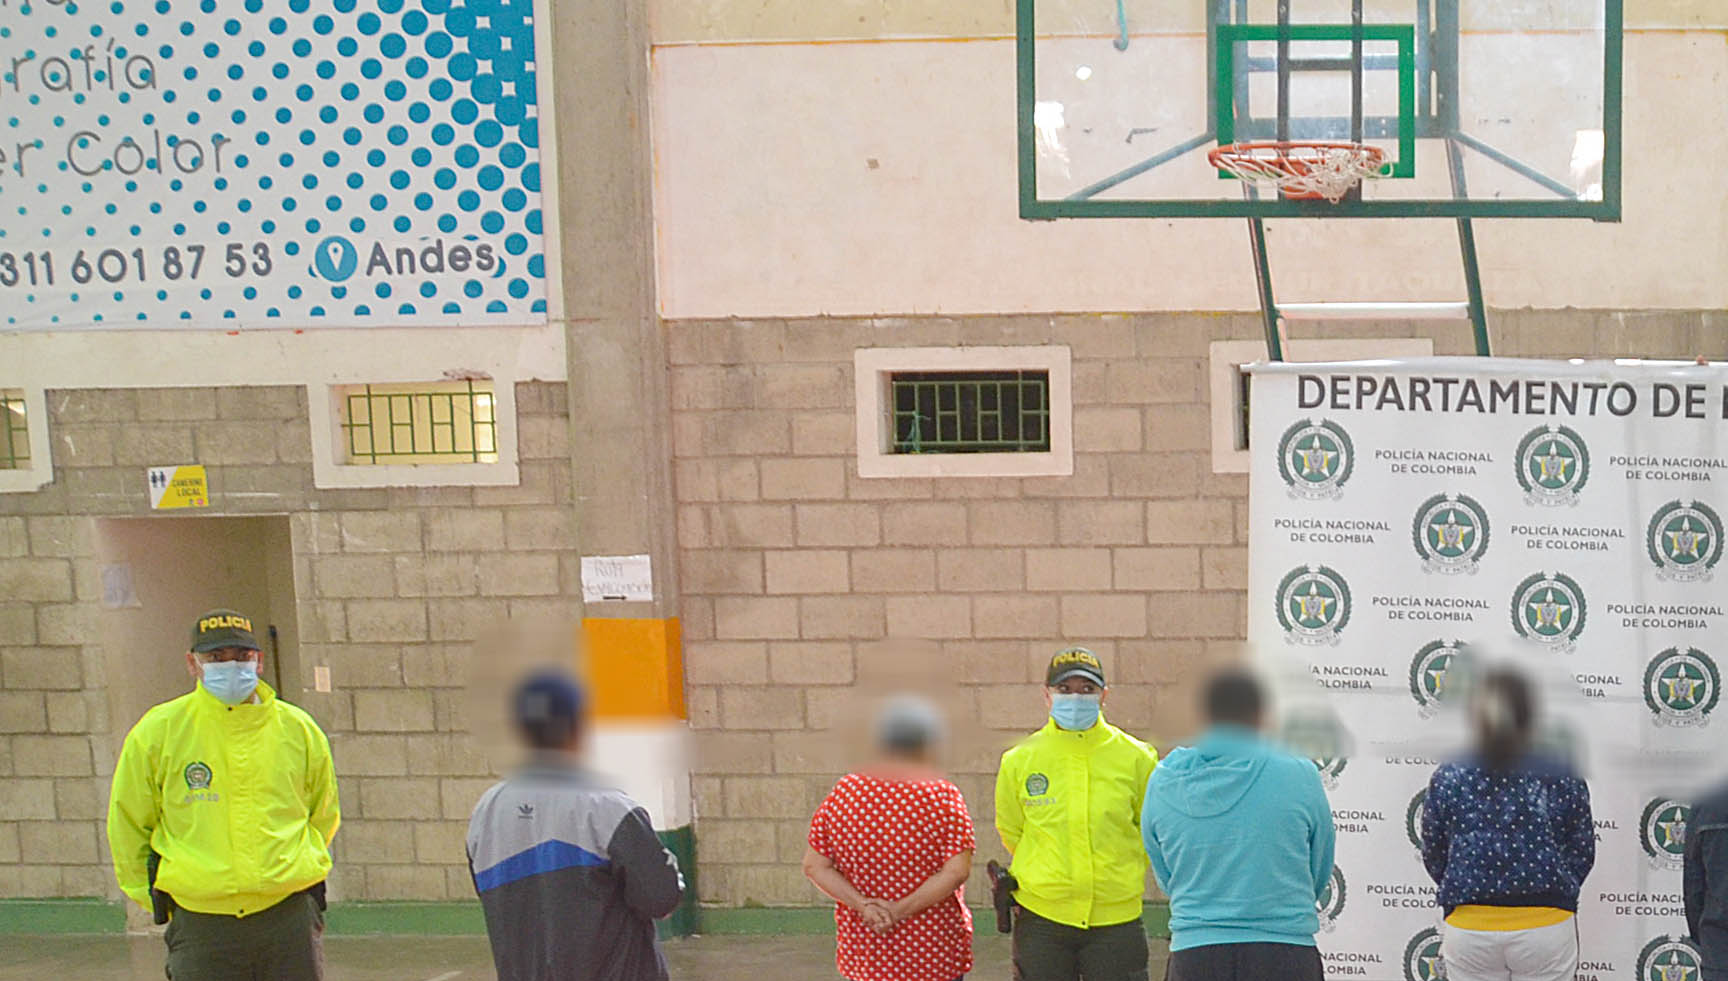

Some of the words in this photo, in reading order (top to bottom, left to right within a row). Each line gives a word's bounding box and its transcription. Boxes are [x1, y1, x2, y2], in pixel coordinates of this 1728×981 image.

[0, 37, 156, 92] rafía
[0, 143, 41, 177] r
[68, 129, 231, 176] Color
[0, 251, 55, 287] 311
[71, 248, 146, 284] 601
[163, 244, 206, 280] 87
[225, 242, 272, 277] 53
[366, 239, 495, 276] Andes
[1298, 375, 1637, 416] DEPARTAMENTO
[1653, 383, 1706, 419] DE
[1376, 450, 1424, 460] POLICÍA
[1428, 452, 1493, 462] NACIONAL
[1610, 457, 1659, 466] POLICÍA
[1663, 458, 1727, 468] NACIONAL
[1392, 464, 1407, 473] DE
[1411, 464, 1476, 474] COLOMBIA
[1626, 471, 1641, 479] DE
[1646, 471, 1711, 481] COLOMBIA
[1275, 519, 1323, 528] POLICÍA
[1326, 521, 1390, 531] NACIONAL
[1511, 526, 1559, 535] POLICÍA
[1562, 528, 1625, 538] NACIONAL
[1291, 533, 1305, 542] DE
[1311, 533, 1374, 543] COLOMBIA
[1527, 540, 1542, 548] DE
[1547, 540, 1608, 551] COLOMBIA
[1373, 597, 1421, 606] POLICÍA
[1425, 598, 1490, 608] NACIONAL
[1607, 604, 1655, 614] POLICÍA
[1659, 606, 1724, 615] NACIONAL
[1389, 611, 1404, 619] DE
[1408, 611, 1473, 621] COLOMBIA
[200, 615, 252, 632] POLICIA
[1623, 618, 1638, 627] DE
[1643, 619, 1707, 628] COLOMBIA
[1053, 651, 1099, 667] POLICIA
[1324, 667, 1388, 676] NACIONAL
[1317, 679, 1371, 688] OLOMBIA
[1576, 674, 1622, 684] CIONAL
[1331, 811, 1384, 820] ACIONAL
[1367, 885, 1415, 894] POLICÍA
[1600, 892, 1648, 902] POLICÍA
[1383, 899, 1398, 907] DE
[1616, 906, 1631, 915] DE
